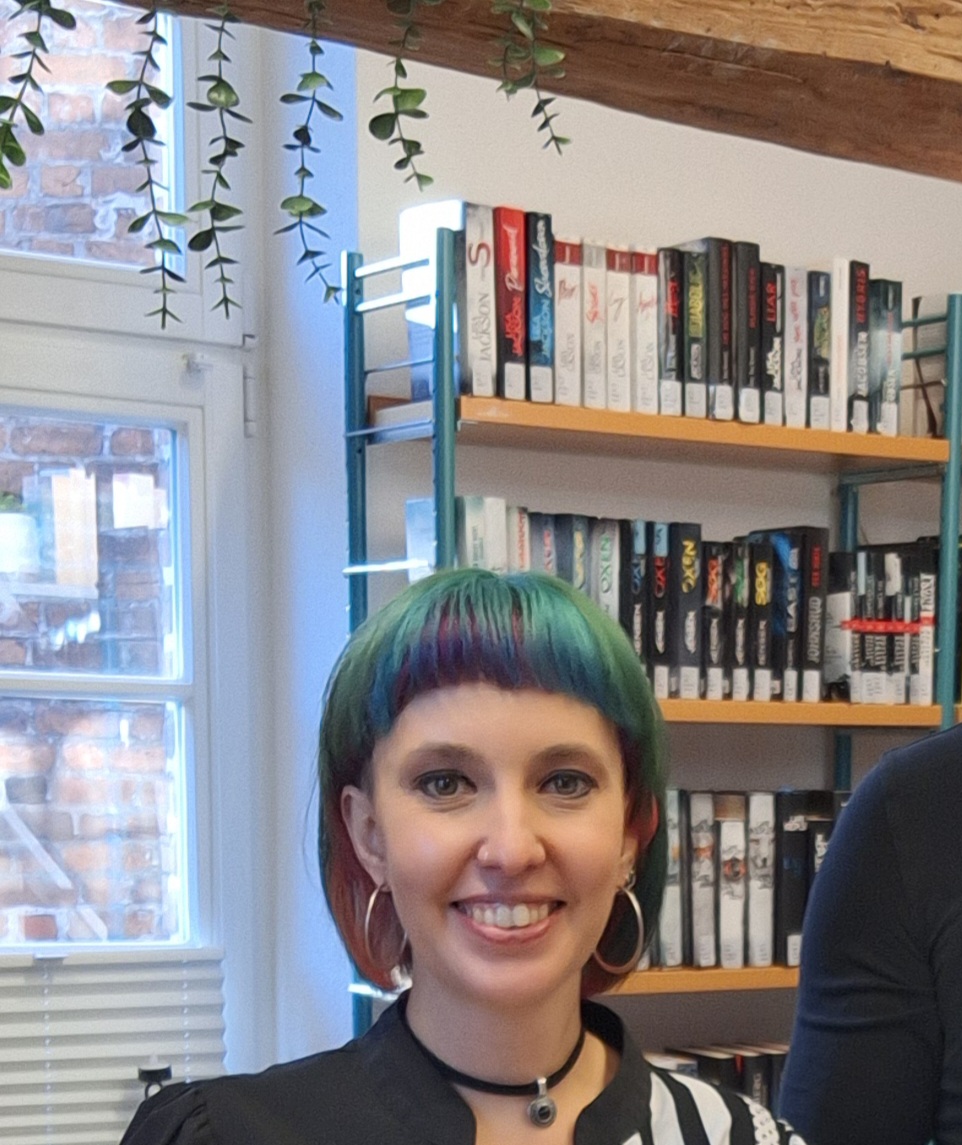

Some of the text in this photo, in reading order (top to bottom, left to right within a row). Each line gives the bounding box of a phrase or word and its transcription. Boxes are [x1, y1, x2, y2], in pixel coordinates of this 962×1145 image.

[468, 241, 491, 268] S
[766, 282, 776, 322] LIAR
[856, 267, 867, 323] HYBRIS
[478, 292, 491, 362] JACKSON
[511, 296, 524, 356] JACKSON
[539, 300, 551, 359] JACKSON
[856, 331, 867, 396] JACOBSEN
[600, 536, 613, 594] OXEN
[654, 557, 667, 598] OXE
[681, 539, 696, 594] OXEN
[808, 597, 821, 663] JOHNSRUD
